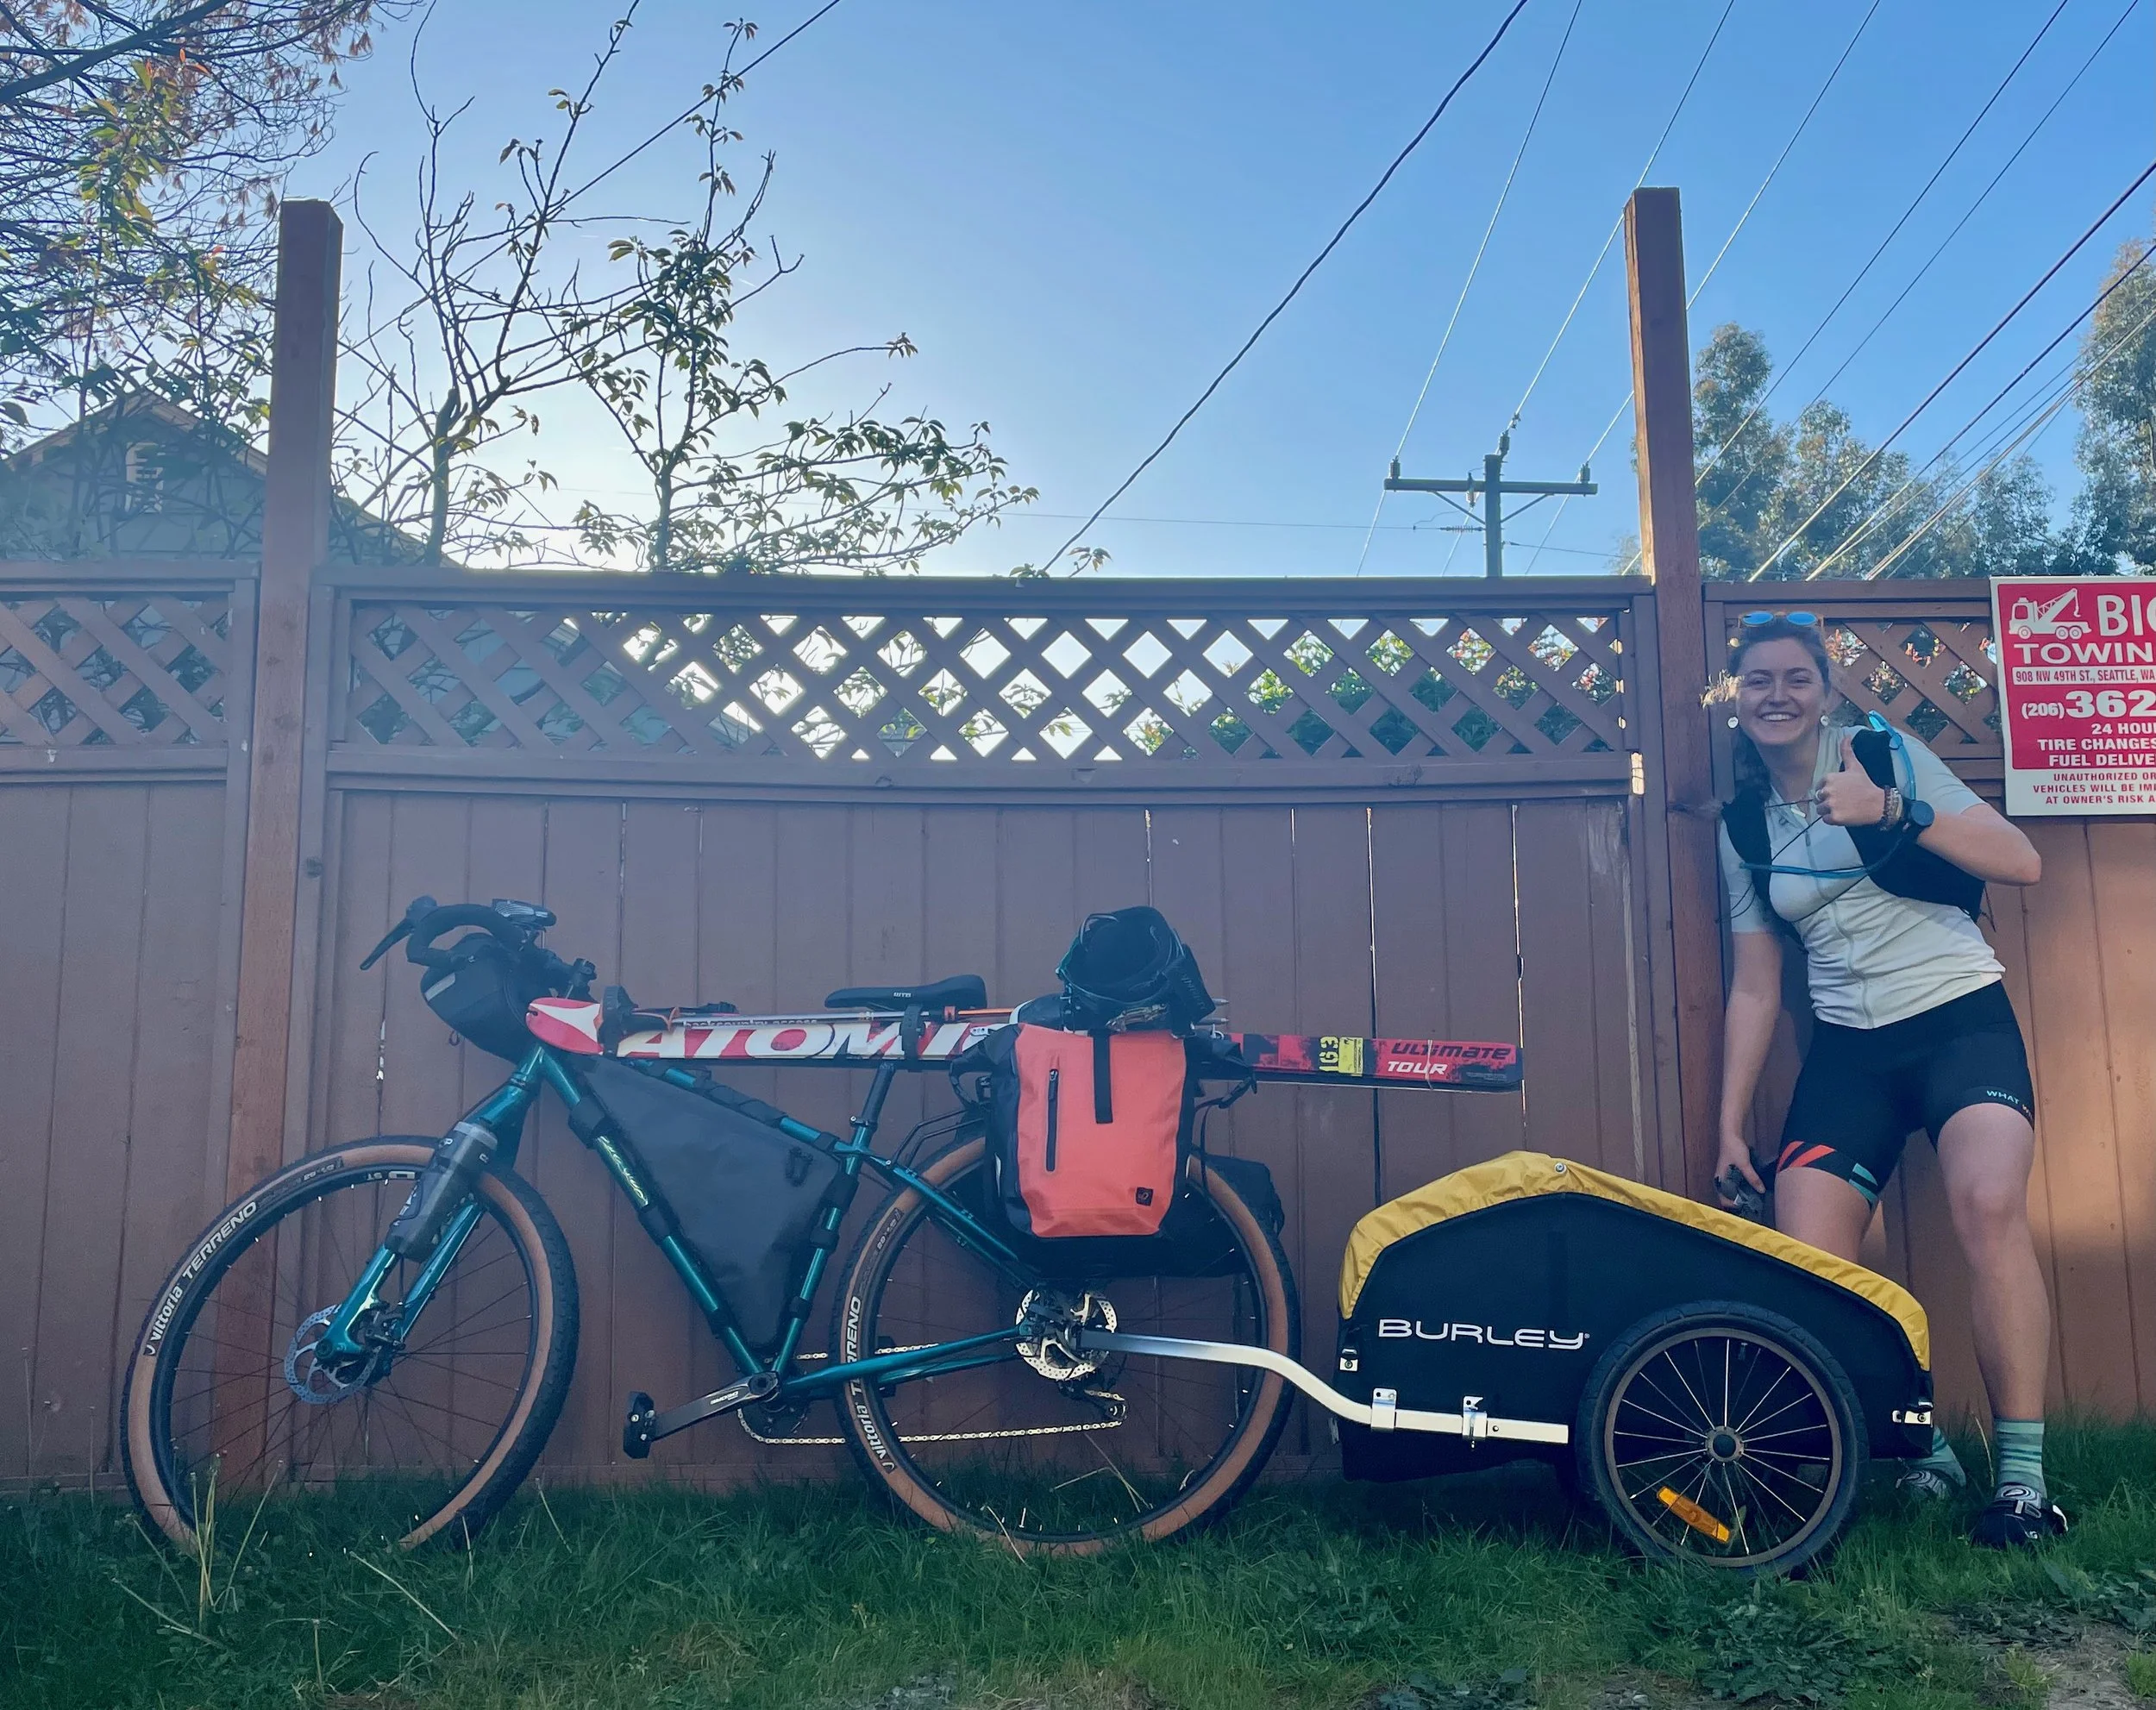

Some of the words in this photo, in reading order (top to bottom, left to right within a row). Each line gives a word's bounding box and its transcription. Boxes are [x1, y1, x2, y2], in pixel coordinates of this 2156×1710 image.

[2097, 594, 2156, 636] BI
[2016, 671, 2033, 682] 908
[2036, 670, 2050, 681] NW
[2054, 670, 2076, 681] 49TH
[2140, 668, 2156, 680] WA
[2021, 703, 2065, 719] (206)
[2091, 723, 2113, 735] 24
[2118, 723, 2156, 735] HOU
[2038, 739, 2077, 751] TIRE
[2049, 754, 2091, 767] FUEL
[2096, 753, 2156, 766] DELIVE
[2053, 772, 2138, 781] UNAUTHORIZED
[2034, 785, 2085, 793] VEHICLES
[2090, 784, 2117, 792] WILL
[2122, 783, 2134, 792] BE
[2046, 796, 2059, 805] AT
[2063, 795, 2113, 805] OWNER'S
[2118, 794, 2145, 803] RISK
[1388, 1061, 1448, 1075] TOUR
[1986, 1090, 2020, 1105] WHAT
[182, 1201, 257, 1280] TERRENO
[845, 1296, 862, 1397] TRRENO
